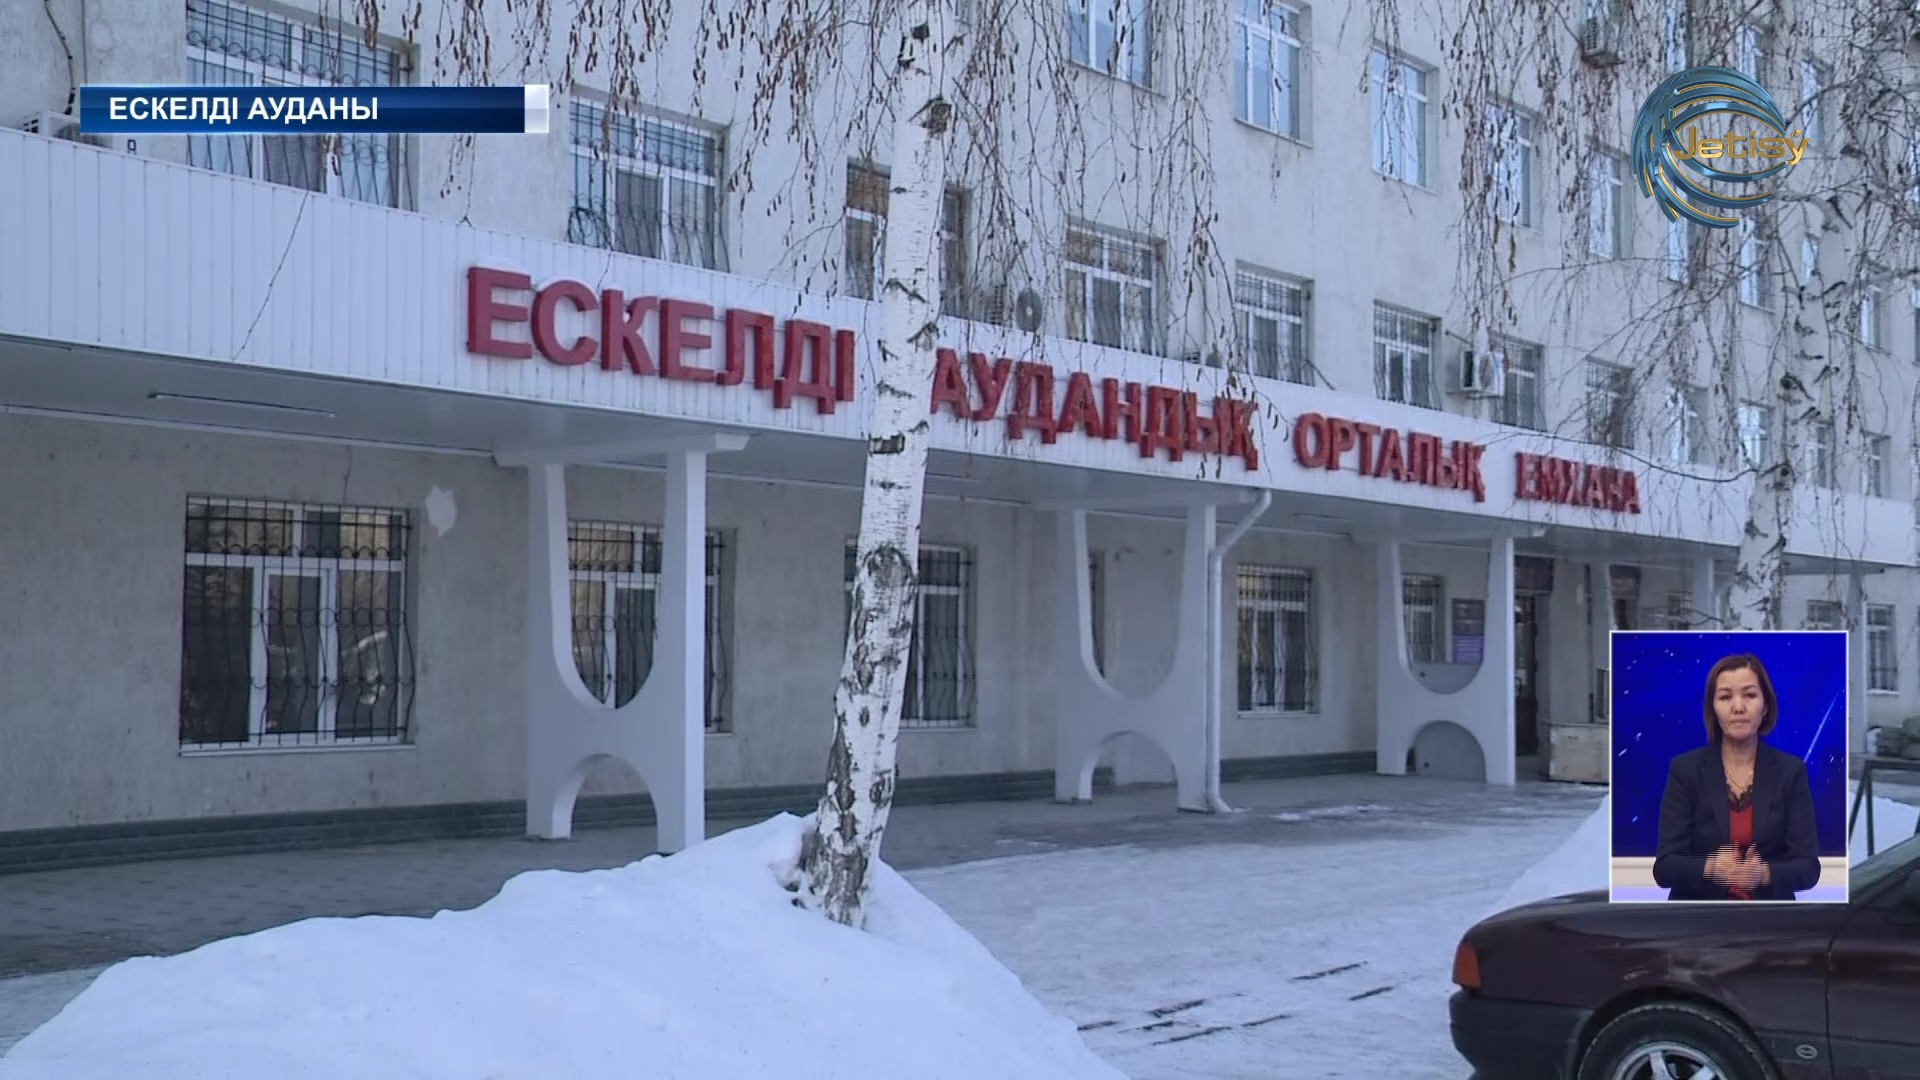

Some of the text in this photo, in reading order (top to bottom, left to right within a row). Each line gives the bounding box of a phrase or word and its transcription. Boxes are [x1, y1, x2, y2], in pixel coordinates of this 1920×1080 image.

[467, 266, 1642, 515] ЕСКЕЛДІ АУДАНДЫҚ ОРТАЛЫҚ ЕМХАНА
